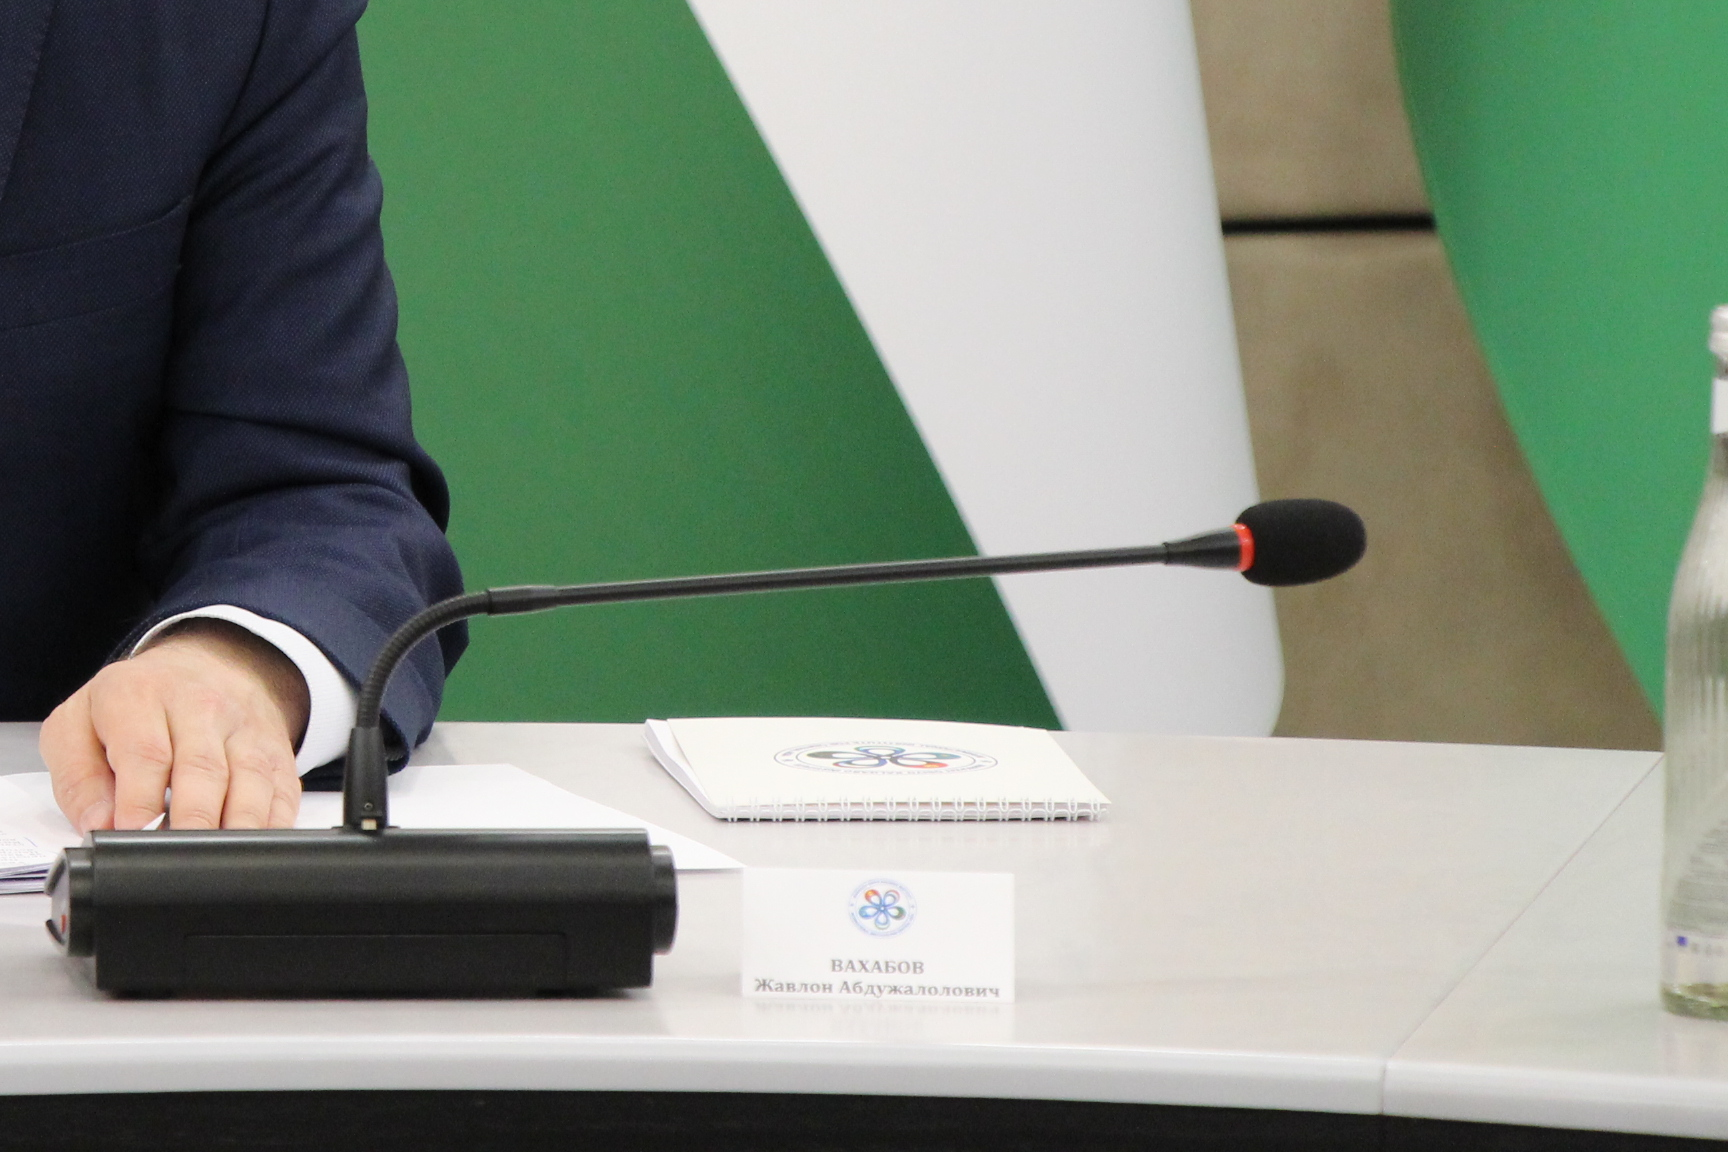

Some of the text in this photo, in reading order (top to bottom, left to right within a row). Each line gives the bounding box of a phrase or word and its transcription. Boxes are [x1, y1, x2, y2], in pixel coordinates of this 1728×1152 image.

[831, 959, 925, 974] ВАХАБОВ
[755, 978, 1000, 998] Жавлон Абдужалолович
